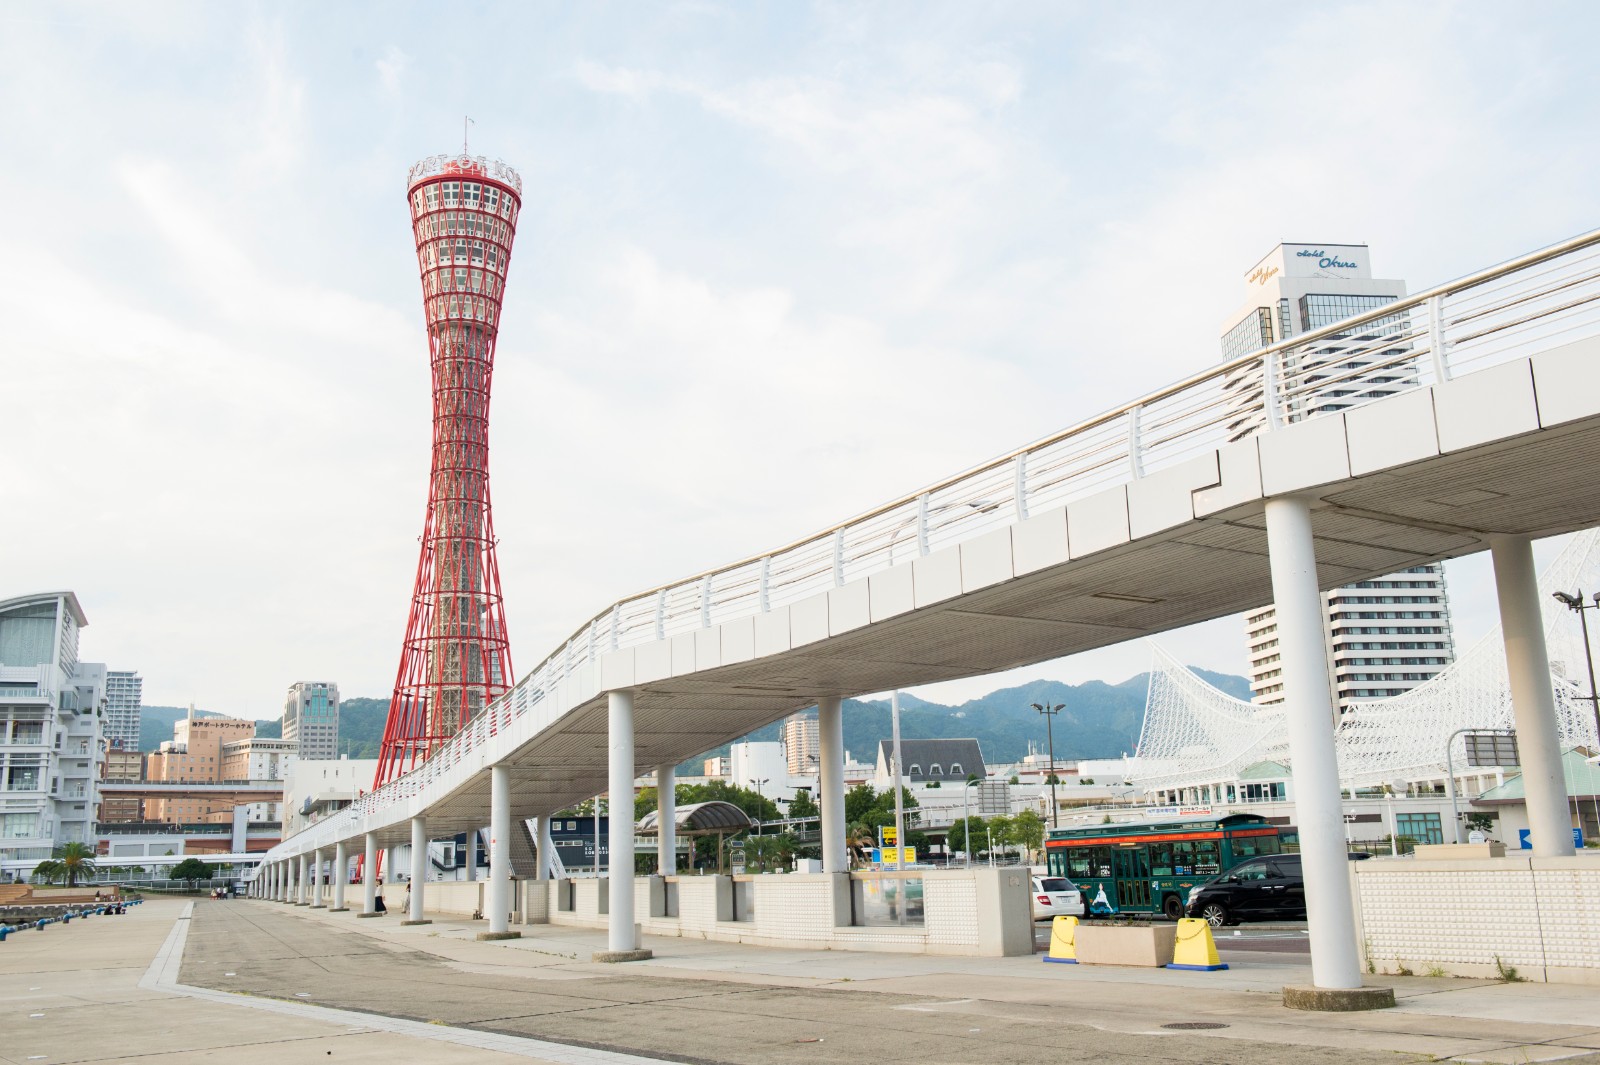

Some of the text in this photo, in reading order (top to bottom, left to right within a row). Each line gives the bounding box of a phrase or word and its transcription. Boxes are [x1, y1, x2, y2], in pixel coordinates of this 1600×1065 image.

[407, 154, 523, 195] PORT OF KOB
[1296, 249, 1325, 258] Hotel
[1318, 255, 1358, 269] Okura
[192, 721, 252, 729] 神戸ポートタワーホテル
